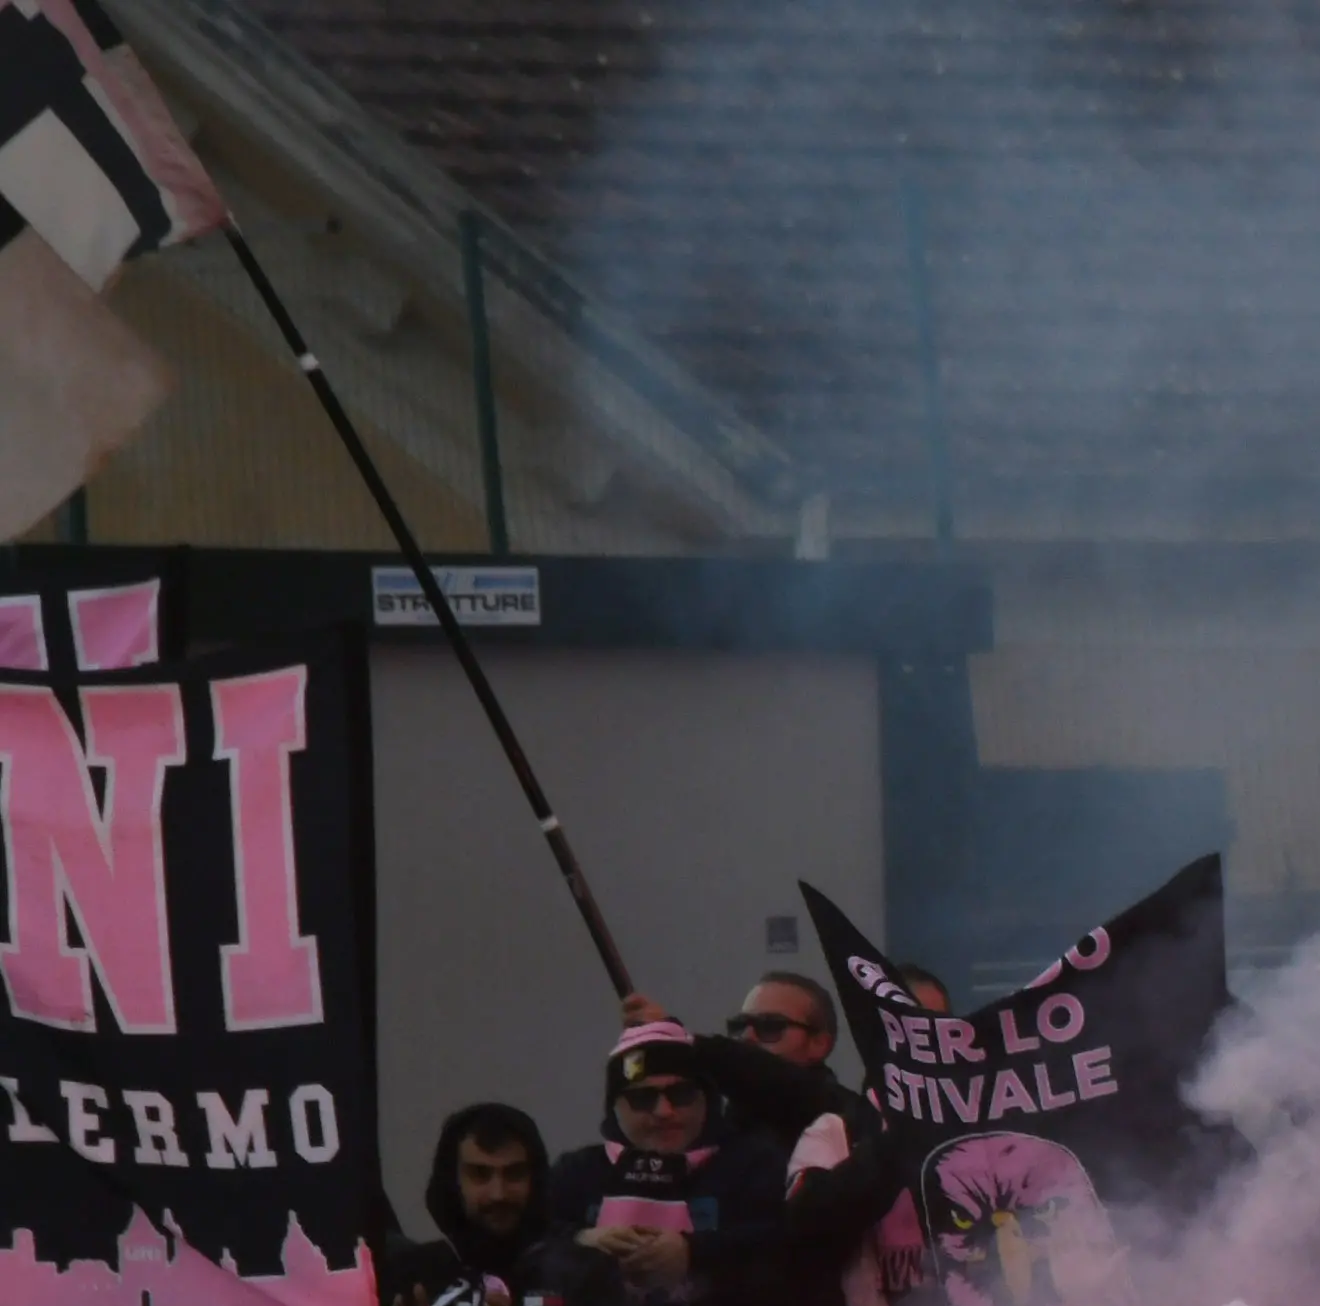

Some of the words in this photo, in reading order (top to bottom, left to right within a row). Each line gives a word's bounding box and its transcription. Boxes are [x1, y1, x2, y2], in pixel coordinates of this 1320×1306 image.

[377, 593, 536, 613] STRTTURE
[879, 1007, 986, 1064] PER
[998, 993, 1086, 1055] LO
[882, 1045, 1118, 1124] STIVALE
